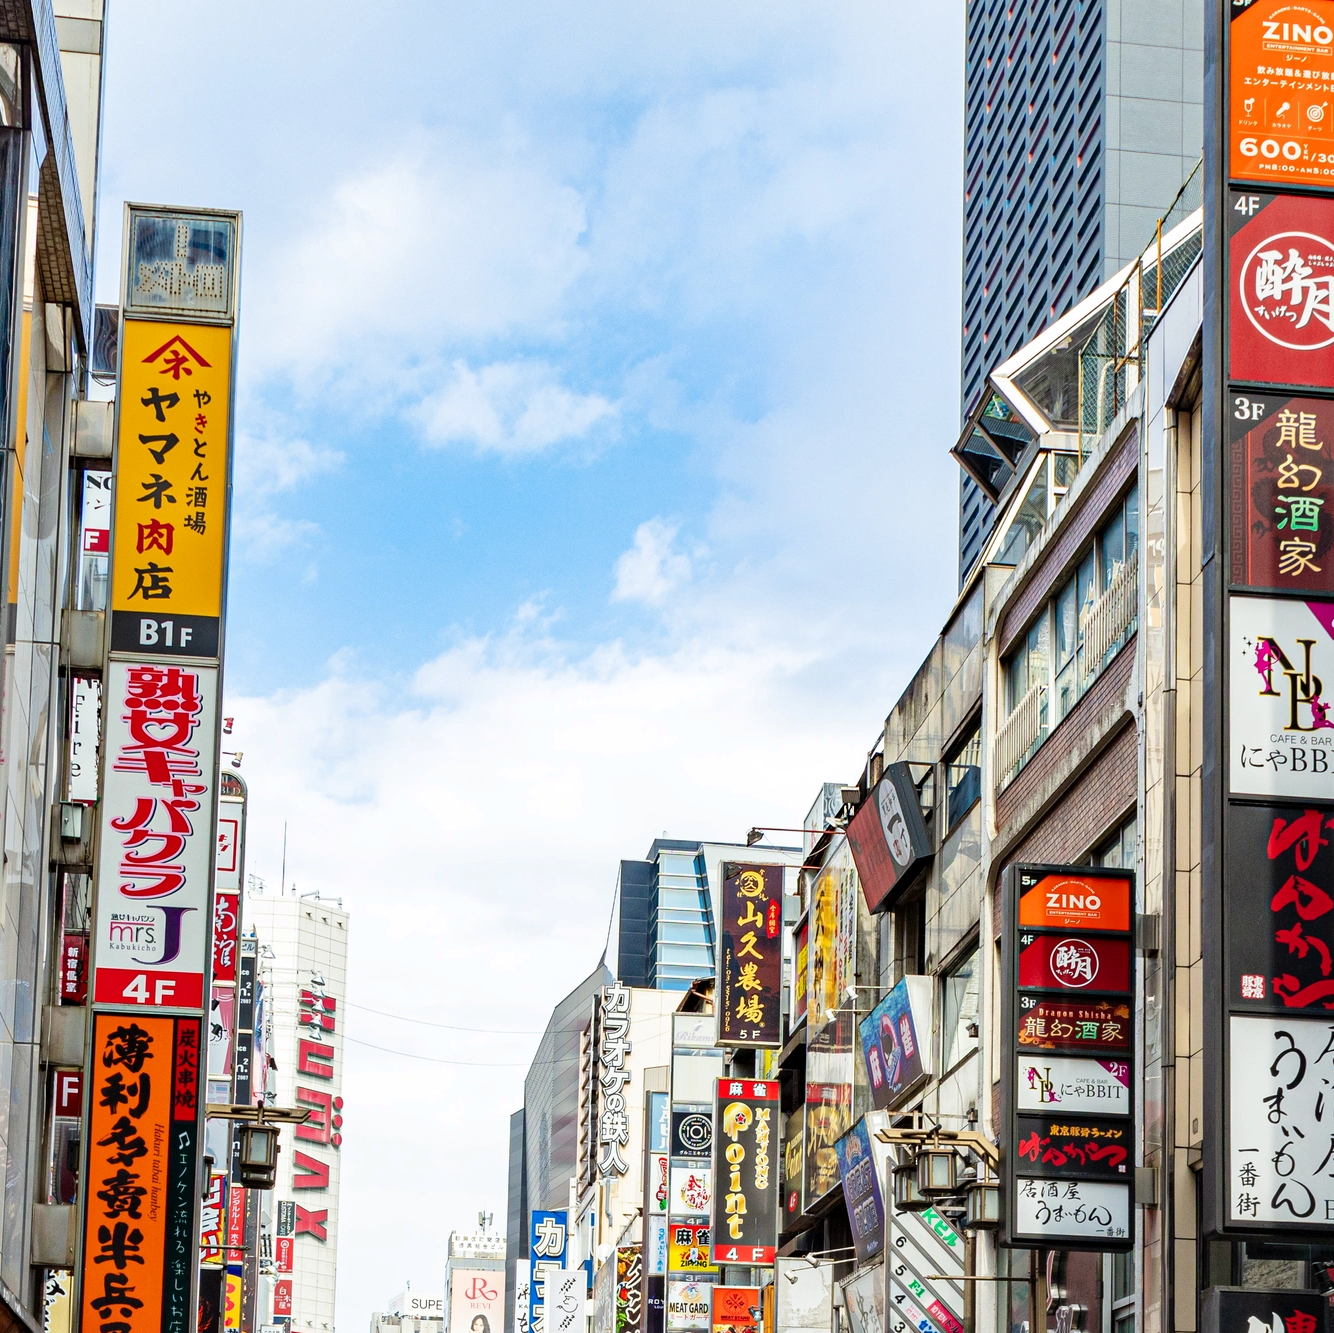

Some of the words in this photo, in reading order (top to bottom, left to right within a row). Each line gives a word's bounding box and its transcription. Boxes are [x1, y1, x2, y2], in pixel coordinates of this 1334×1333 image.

[1262, 21, 1333, 45] ZINO
[1267, 43, 1315, 52] ENTERTAINMENT
[1233, 195, 1260, 216] 4F
[1233, 398, 1265, 421] 3F
[183, 389, 212, 536] やきとん酒場
[127, 386, 181, 600] ヤマネ肉店
[139, 618, 193, 648] B1F
[1270, 734, 1294, 745] CAFE
[1308, 735, 1333, 746] BAR
[110, 666, 207, 900] 熟女キャバクラ
[1021, 876, 1037, 886] 5F
[1046, 893, 1102, 909] ZINO
[109, 942, 156, 952] Kabukicho
[1021, 935, 1034, 945] 4F
[122, 974, 177, 1004] 4F
[1021, 996, 1037, 1008] 3F
[1038, 1008, 1075, 1018] Dragon
[1078, 1010, 1112, 1020] Shisha
[175, 1028, 198, 1109] 炭火串焼
[1109, 1061, 1128, 1077] 2F
[597, 980, 633, 1176] カラオケの鉄人
[729, 1082, 767, 1098] 麻雀
[1050, 1124, 1123, 1138] 東京豚骨ラーメン
[755, 1108, 771, 1190] MAHJONG
[1019, 1181, 1082, 1201] 居酒屋
[1235, 1146, 1261, 1219] 一番街
[726, 1248, 765, 1262] 4F
[470, 1302, 491, 1310] REVI
